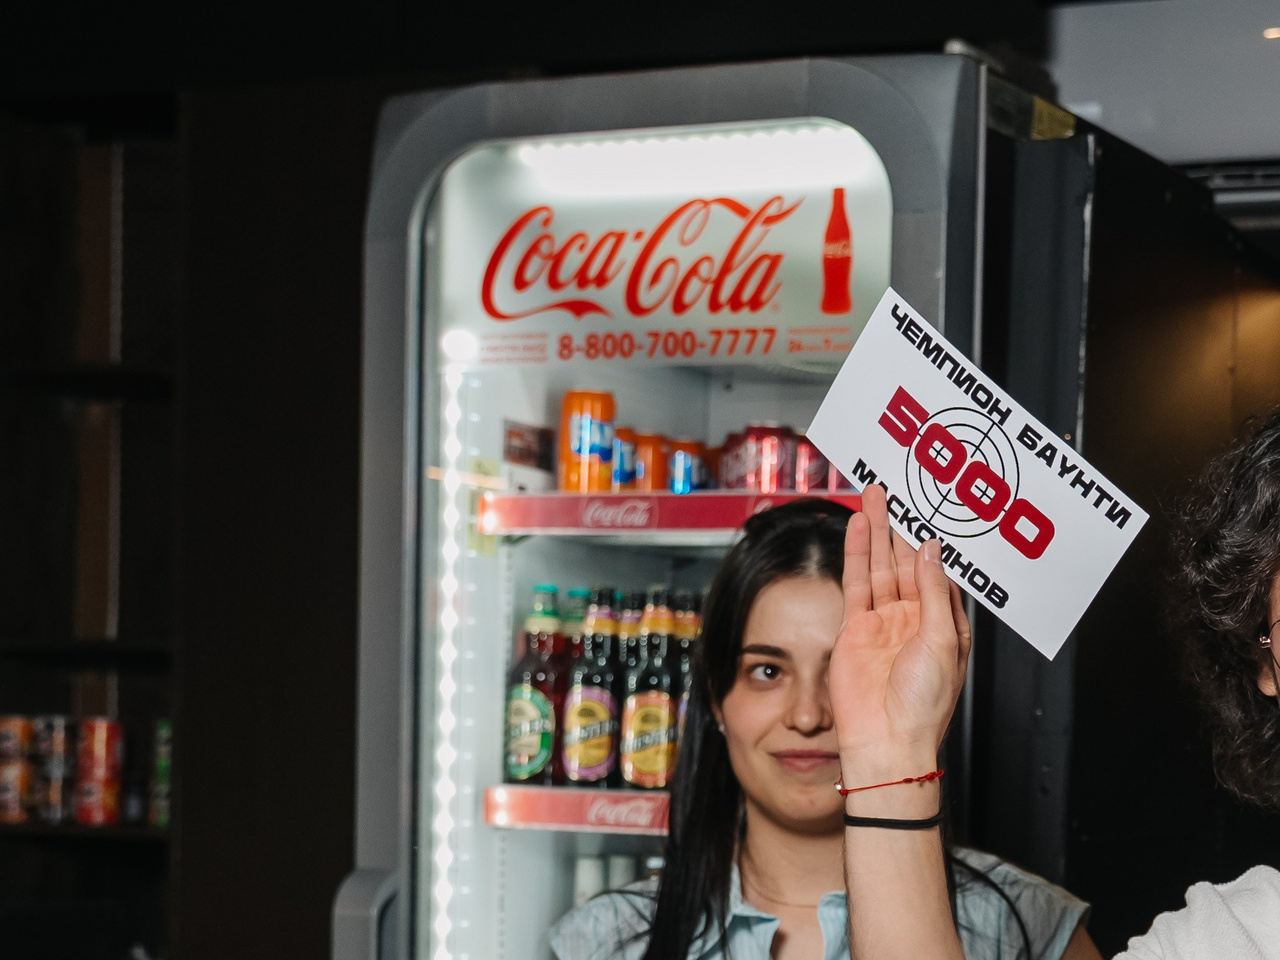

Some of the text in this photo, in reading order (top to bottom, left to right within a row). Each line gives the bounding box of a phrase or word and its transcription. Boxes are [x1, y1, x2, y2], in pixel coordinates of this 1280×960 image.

[480, 195, 802, 321] Coca-Cola
[557, 326, 777, 361] 8-800-700-7777
[891, 303, 1132, 529] ЧЕМПИОН БАУНТИ
[851, 457, 1010, 609] МСКОИНОВ
[878, 385, 1055, 560] 5000
